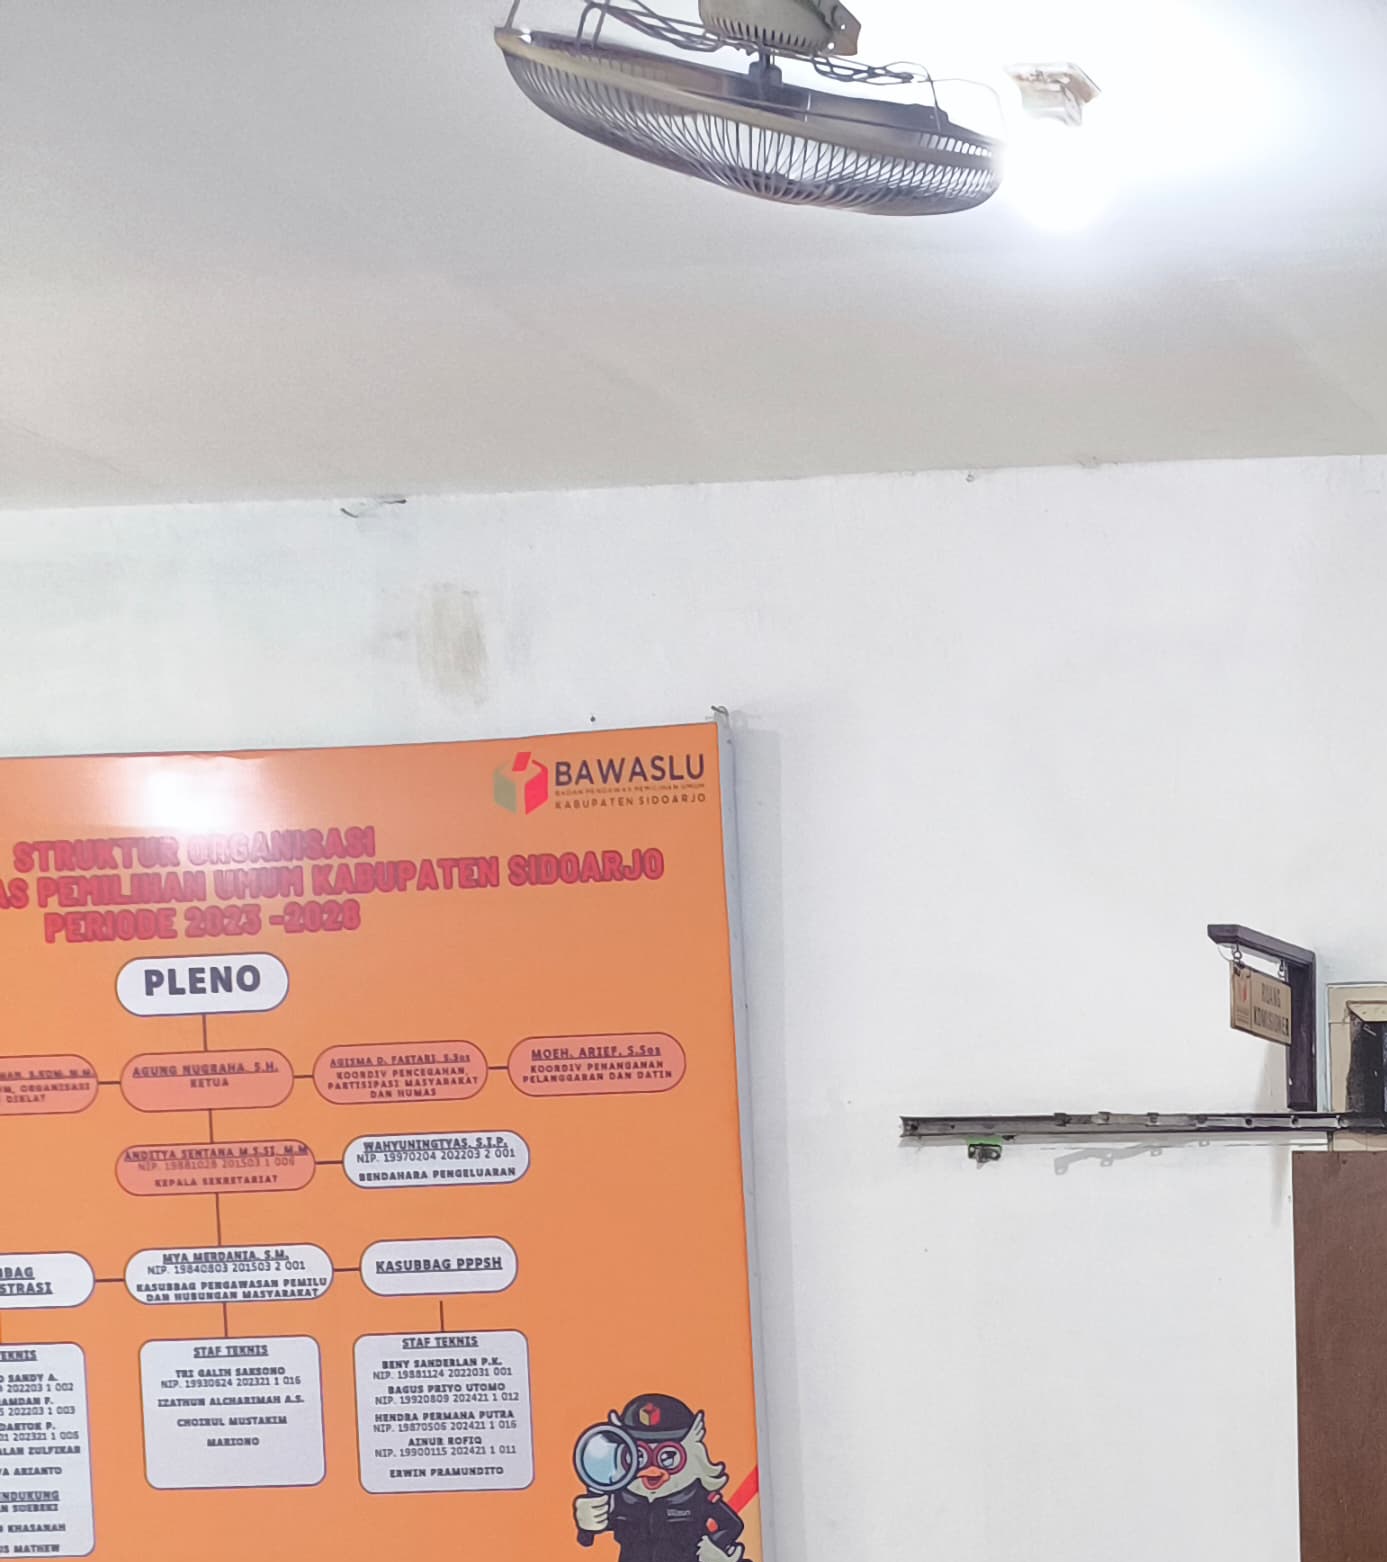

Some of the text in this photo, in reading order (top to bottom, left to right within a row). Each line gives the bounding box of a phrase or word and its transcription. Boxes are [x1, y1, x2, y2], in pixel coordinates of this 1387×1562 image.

[555, 753, 705, 786] BAWASLU
[555, 793, 706, 809] KABUPATEN SIDOARJO
[13, 826, 376, 874] STRUKTUR ORGANISASI
[37, 869, 208, 908] PEMILIHAN
[214, 865, 304, 900] UMUM
[311, 856, 499, 896] KABUPATEN
[508, 847, 665, 887] SIDOARJO
[43, 907, 178, 943] PERIODE
[184, 903, 262, 938] 2023
[143, 964, 262, 996] PLENO
[532, 1049, 574, 1060] MOEH.
[132, 1065, 177, 1078] AGUNG
[530, 1064, 582, 1073] KOORDIV
[189, 1077, 229, 1088] KETUA
[523, 1070, 672, 1083] PELANGGARAN DAN DATIN
[370, 1088, 436, 1098] DAN HUMAS
[357, 1149, 516, 1163] NIP. 202203 2 001
[359, 1168, 516, 1181] BENDAHARA PENGELUARAN
[155, 1175, 278, 1187] KEPALA SEKRETARIAT
[163, 1252, 188, 1264] MYA
[233, 1262, 271, 1272] 201503
[275, 1262, 281, 1271] 2
[285, 1261, 306, 1270] 001
[376, 1257, 502, 1273] KASUBBAG PPPSH
[136, 1278, 328, 1292] KASUBBAG PENGAWASAN PEMILU
[146, 1288, 319, 1302] DAN HUBUNGAN MASYARAKAT
[403, 1336, 478, 1348] STAF TEKNIS
[194, 1345, 269, 1358] STAF TEKNIS
[382, 1360, 410, 1369] BENY
[414, 1358, 477, 1368] SANDERLAN
[176, 1367, 286, 1378] TRI SAKSONO
[373, 1371, 394, 1380] NIP.
[448, 1368, 489, 1378] 2022031
[494, 1367, 512, 1376] 001
[388, 1383, 506, 1395] BAGUS PRIYO UTOMO
[375, 1396, 396, 1405] NIP.
[453, 1393, 489, 1402] 202421
[501, 1392, 519, 1401] 012
[177, 1416, 287, 1427] CHOIRUL MUSTAKIM
[375, 1410, 514, 1422] HENDRA PERMANA PUTRA
[374, 1424, 395, 1433] NIP.
[451, 1421, 485, 1430] 202421
[408, 1436, 482, 1446] AINUR ROFIQ
[375, 1449, 397, 1458] NIP.
[451, 1446, 486, 1455] 202421
[499, 1445, 516, 1454] 011
[390, 1466, 504, 1478] ERWIN PRAMUNDITO
[8, 1523, 66, 1533] KHASANAH
